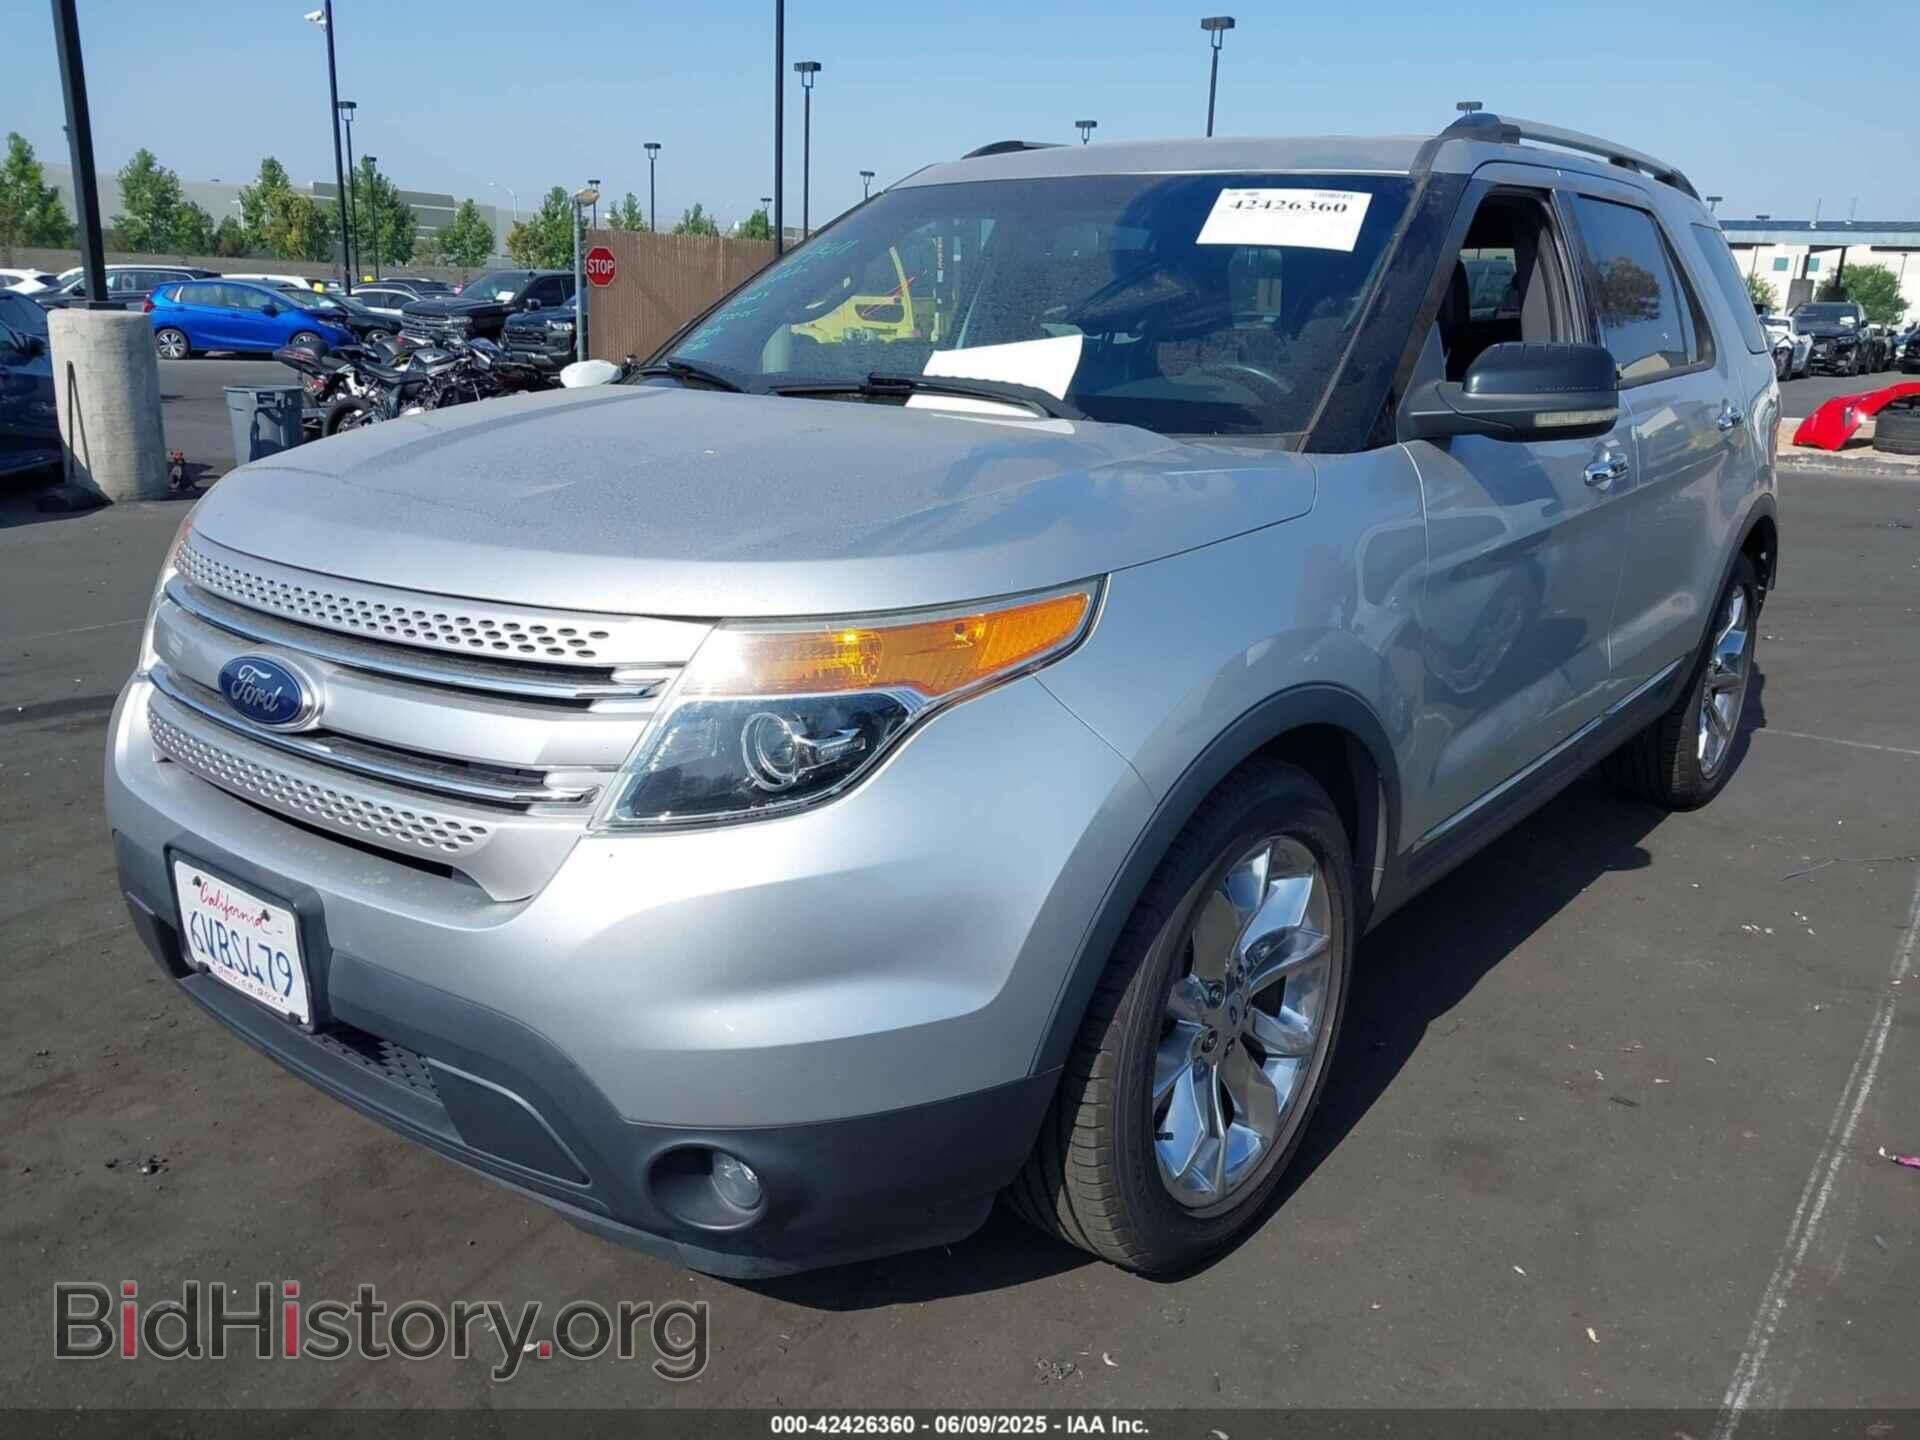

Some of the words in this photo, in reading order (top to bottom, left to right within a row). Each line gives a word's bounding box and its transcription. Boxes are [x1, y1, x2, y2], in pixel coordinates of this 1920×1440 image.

[1229, 199, 1348, 213] 42426360
[588, 259, 615, 275] STOP
[231, 664, 283, 712] Ford
[199, 881, 267, 931] California
[189, 910, 293, 998] 6VBS479
